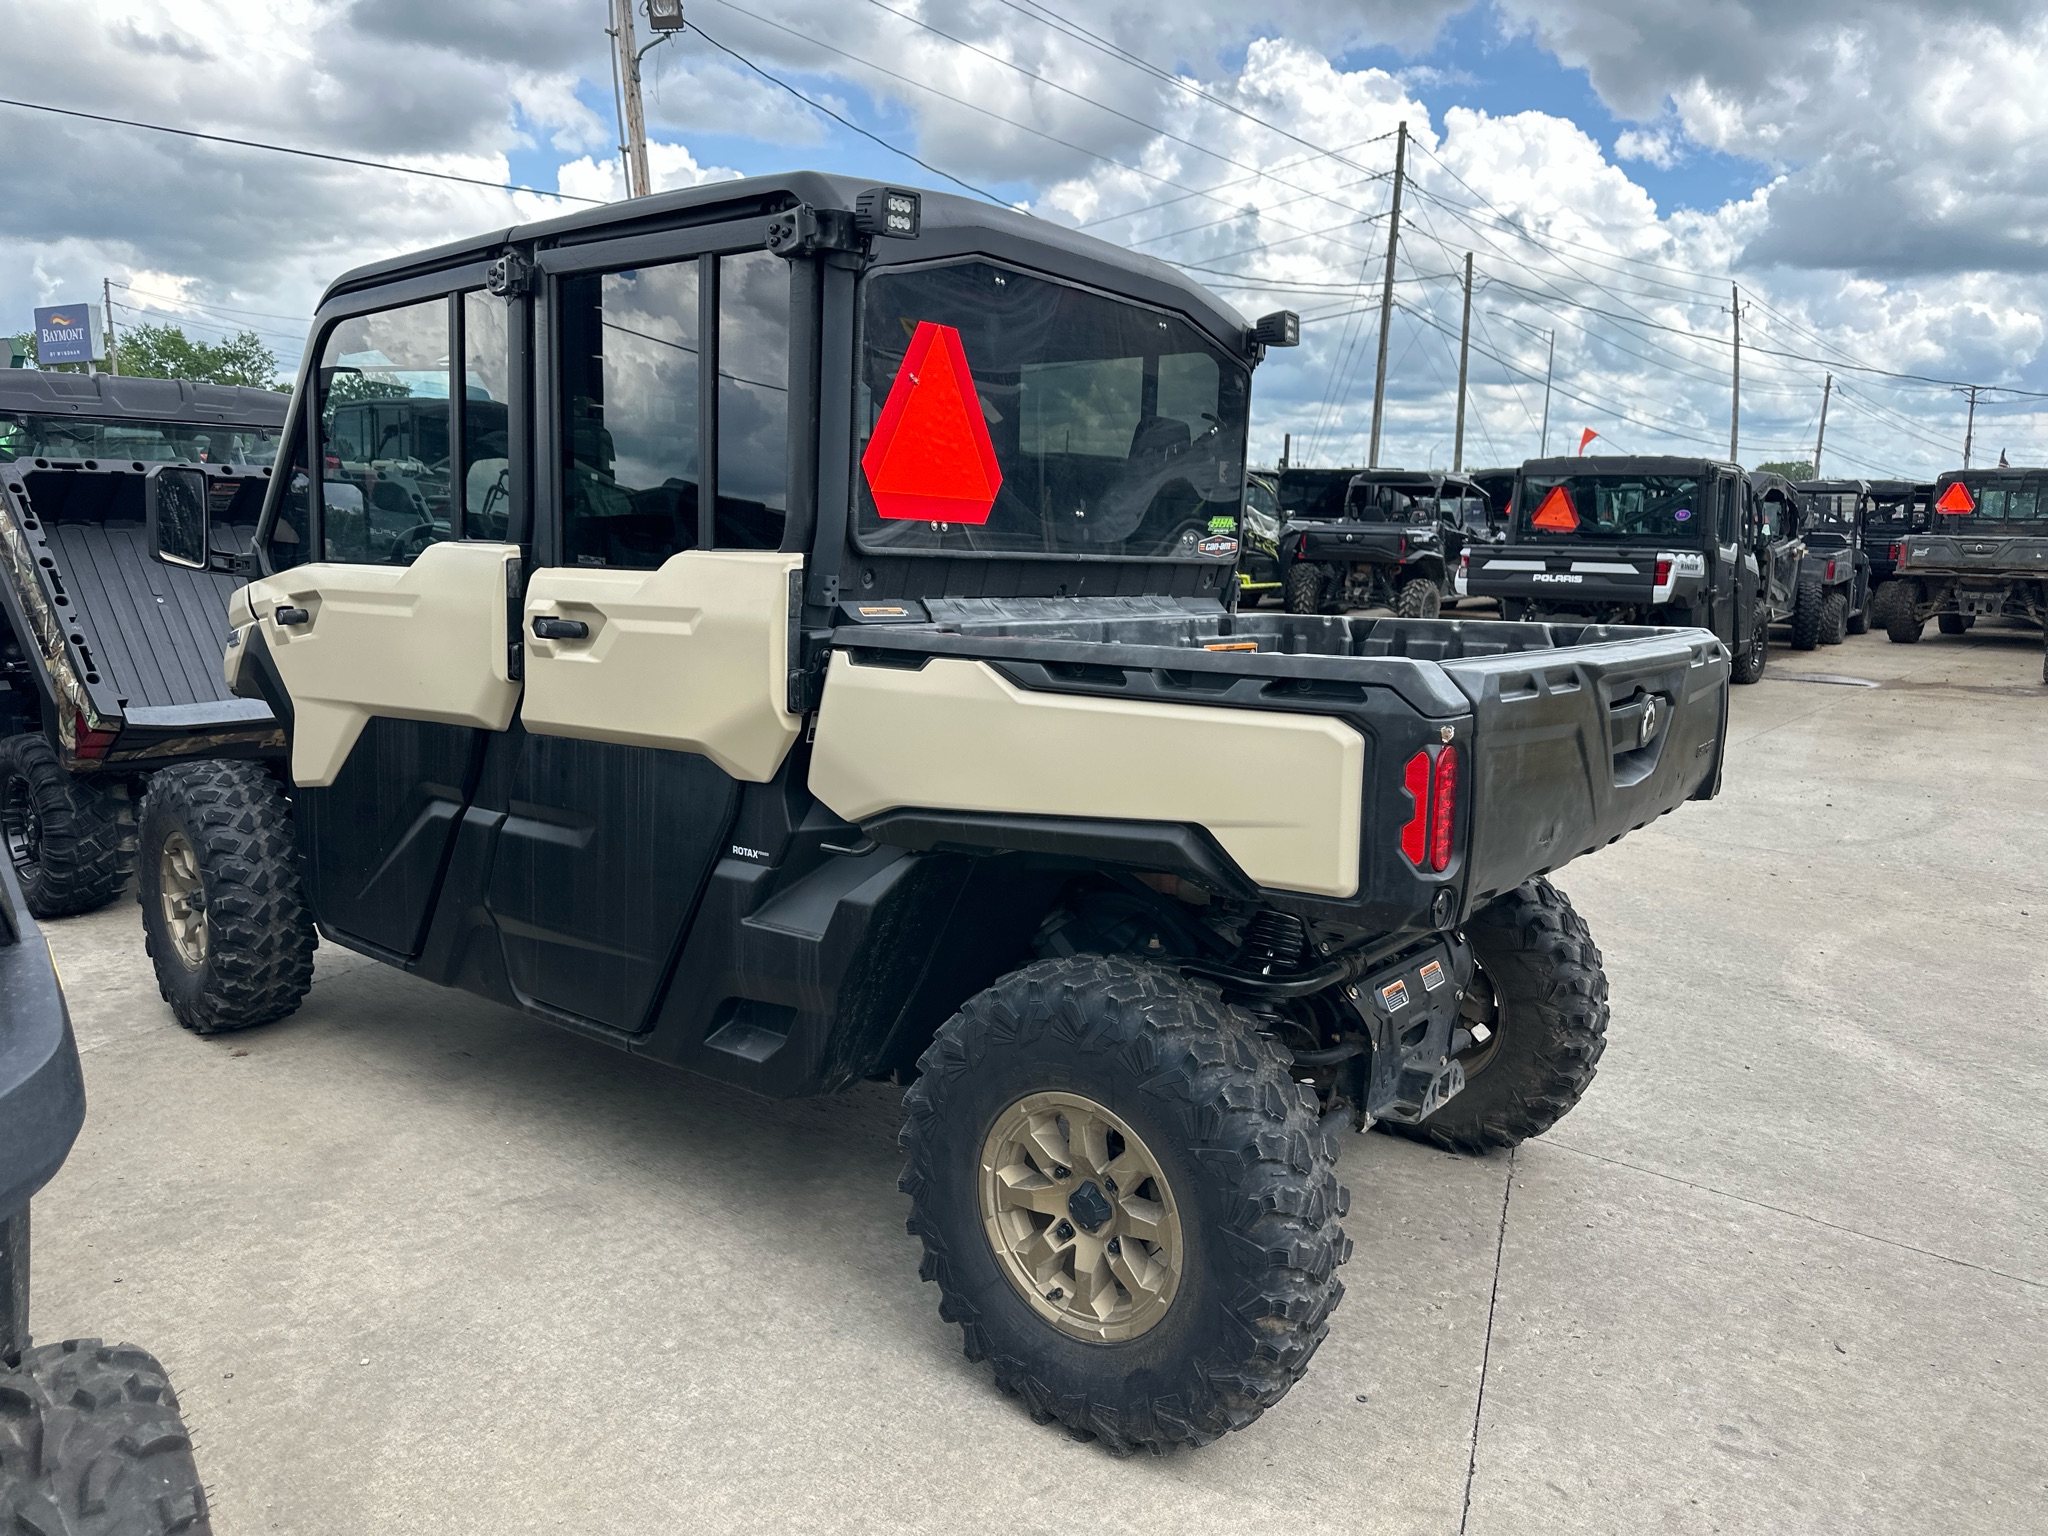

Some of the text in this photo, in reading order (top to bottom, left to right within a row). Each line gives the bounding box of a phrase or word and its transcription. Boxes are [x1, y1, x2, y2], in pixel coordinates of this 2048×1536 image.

[42, 328, 84, 342] BAYMONT
[1681, 563, 1699, 571] RANGER
[1532, 573, 1583, 583] POLARIS
[732, 845, 759, 859] ROTAX
